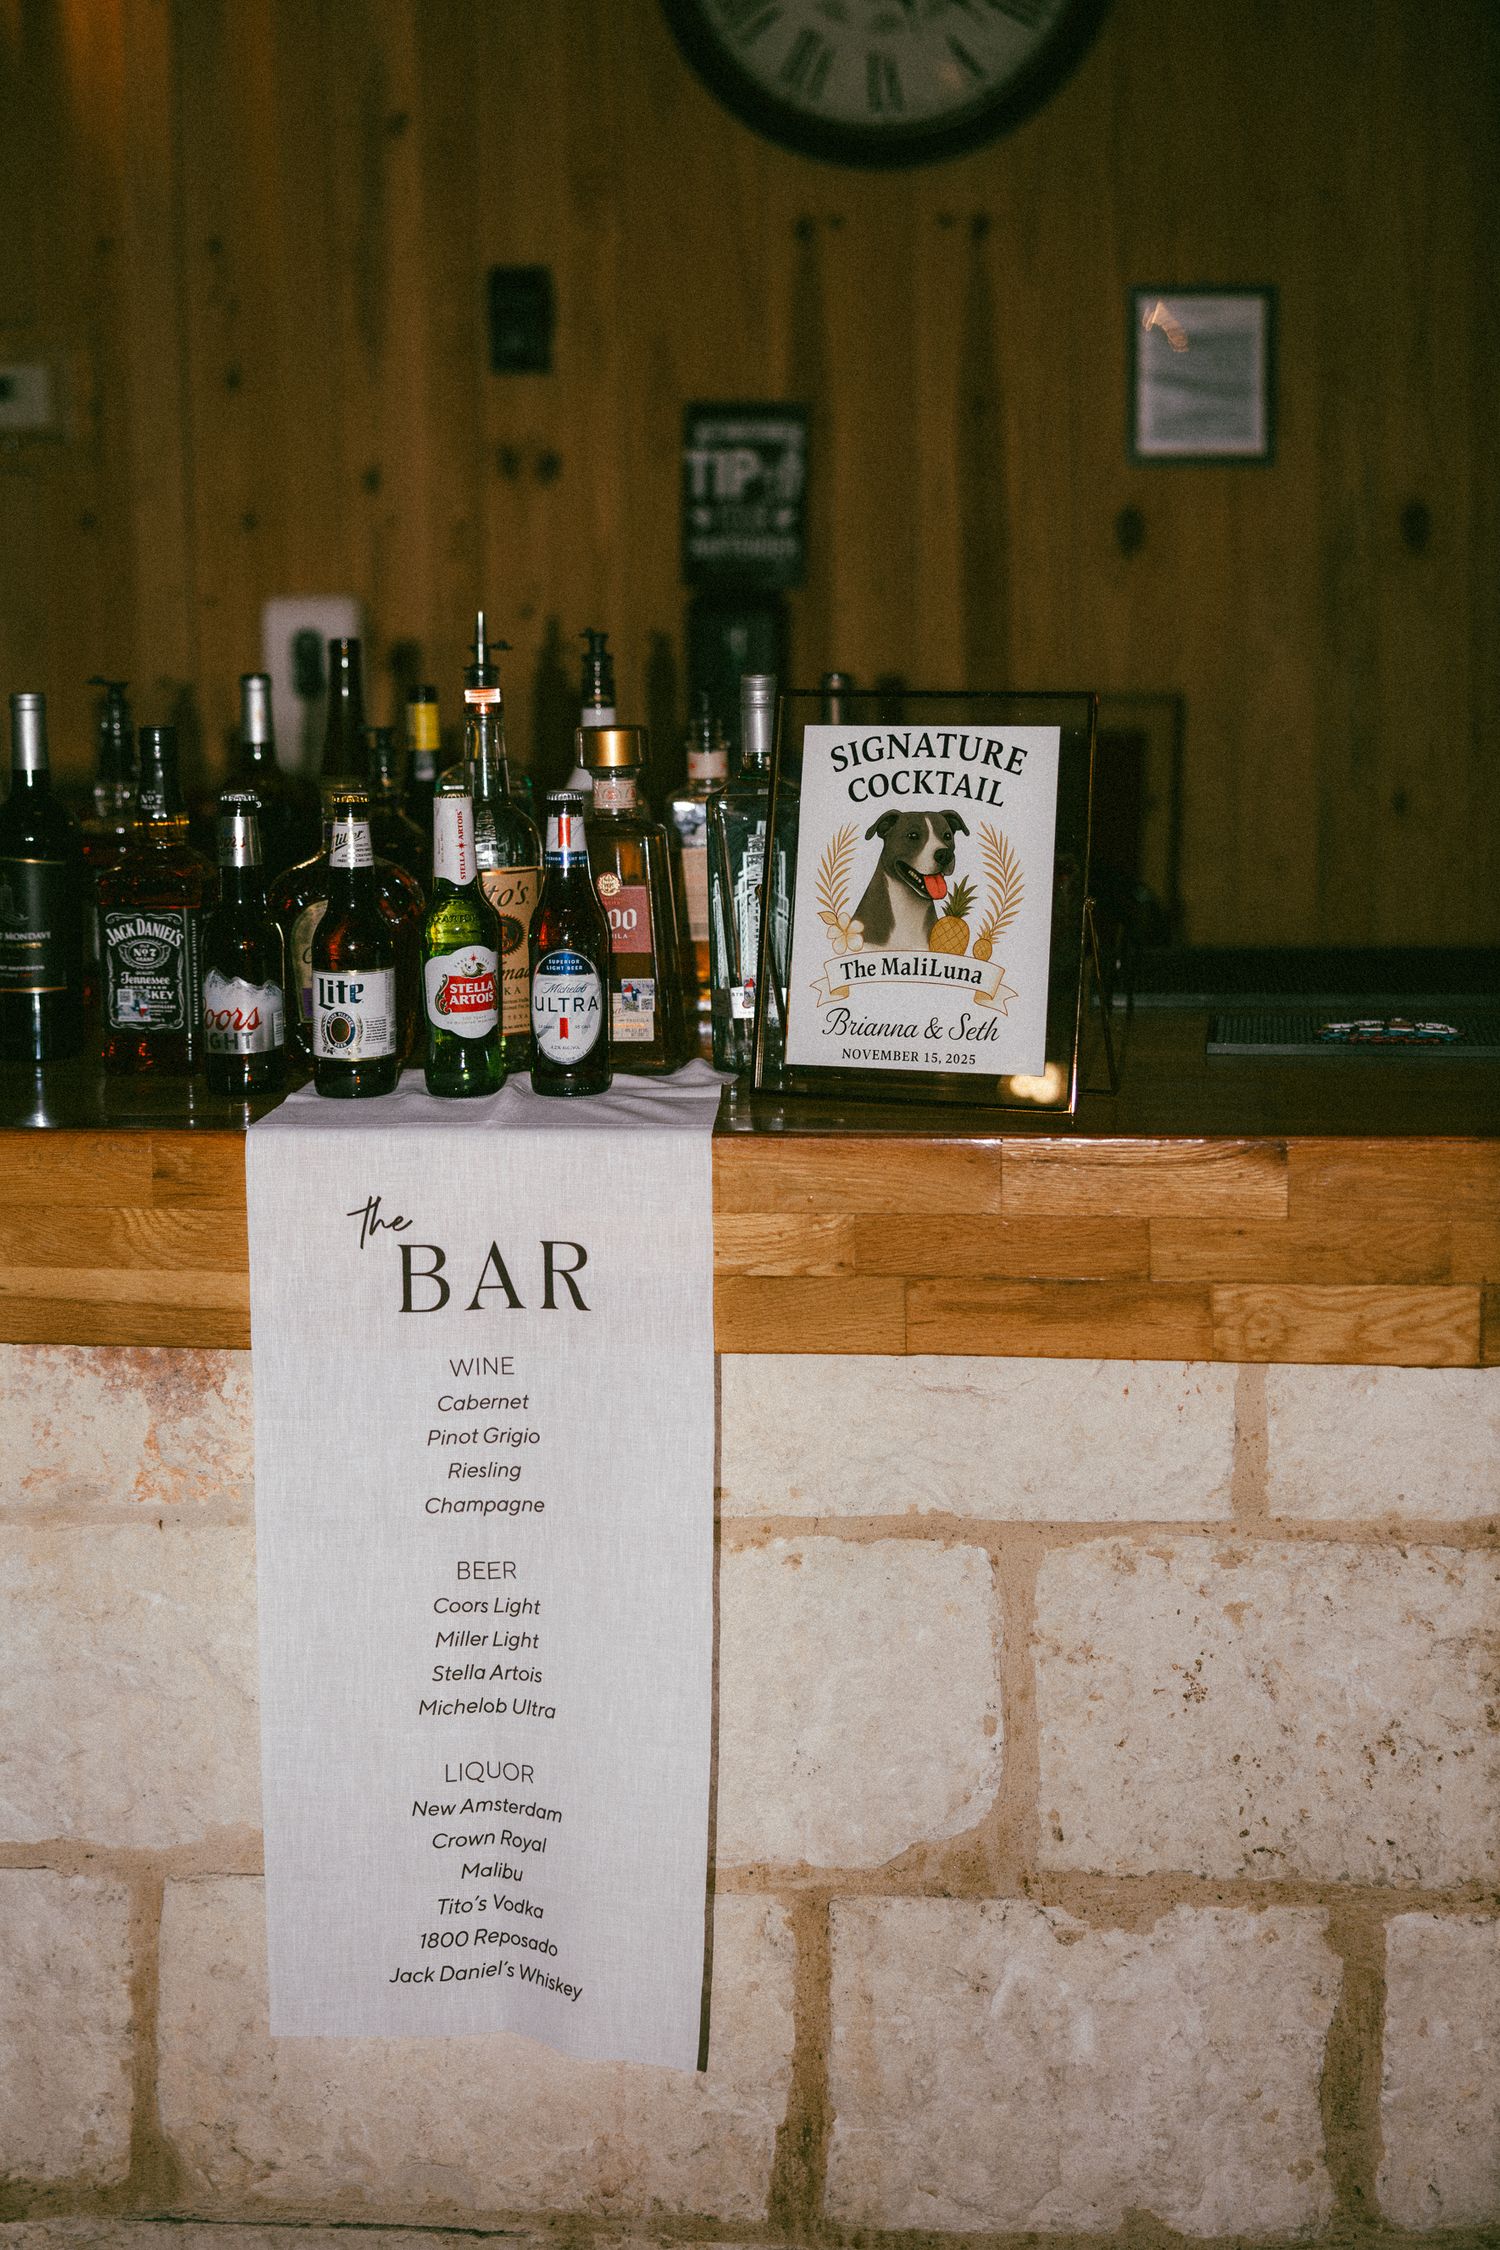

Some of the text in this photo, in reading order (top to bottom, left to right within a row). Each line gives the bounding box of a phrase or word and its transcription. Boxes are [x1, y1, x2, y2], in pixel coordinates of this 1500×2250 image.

[830, 732, 1028, 776] SIGNATURE
[847, 769, 1004, 808] COCKTAIL
[459, 851, 467, 880] STELLA
[106, 918, 184, 947] JACK DANIEL'S
[121, 971, 170, 985] Tennessee
[840, 956, 983, 984] The MaliLuna
[318, 977, 365, 1011] Lite
[450, 980, 494, 994] STELLA
[541, 982, 595, 994] Michelob
[450, 992, 494, 1006] ARTOIS
[534, 995, 599, 1013] ULTRA
[203, 997, 262, 1031] oors
[822, 1006, 1000, 1043] Brianna & Seth
[841, 1048, 976, 1066] NOVEMBER 15, 2025
[346, 1195, 413, 1250] the
[397, 1240, 592, 1314] BAR
[449, 1356, 515, 1378] WINE
[437, 1394, 530, 1412] Cabernet
[427, 1427, 541, 1448] Pinot Grigio
[447, 1461, 522, 1482] Riesling
[424, 1497, 545, 1517] Champagne
[457, 1560, 517, 1580] BEER
[433, 1597, 541, 1617] Coors Light
[435, 1630, 539, 1651] Miller Light
[431, 1664, 543, 1683] Stella Artois
[418, 1697, 556, 1719] Michelob Ultra
[445, 1761, 535, 1784] LIQUOR
[411, 1798, 563, 1823] New Amsterdam
[432, 1829, 548, 1853] Crown Royal
[461, 1861, 524, 1882] Malibu
[438, 1894, 544, 1919] Tito's Vodka
[420, 1928, 558, 1956] 1800 Reposado
[389, 1960, 584, 2002] Jack Daniel's Whiskey
